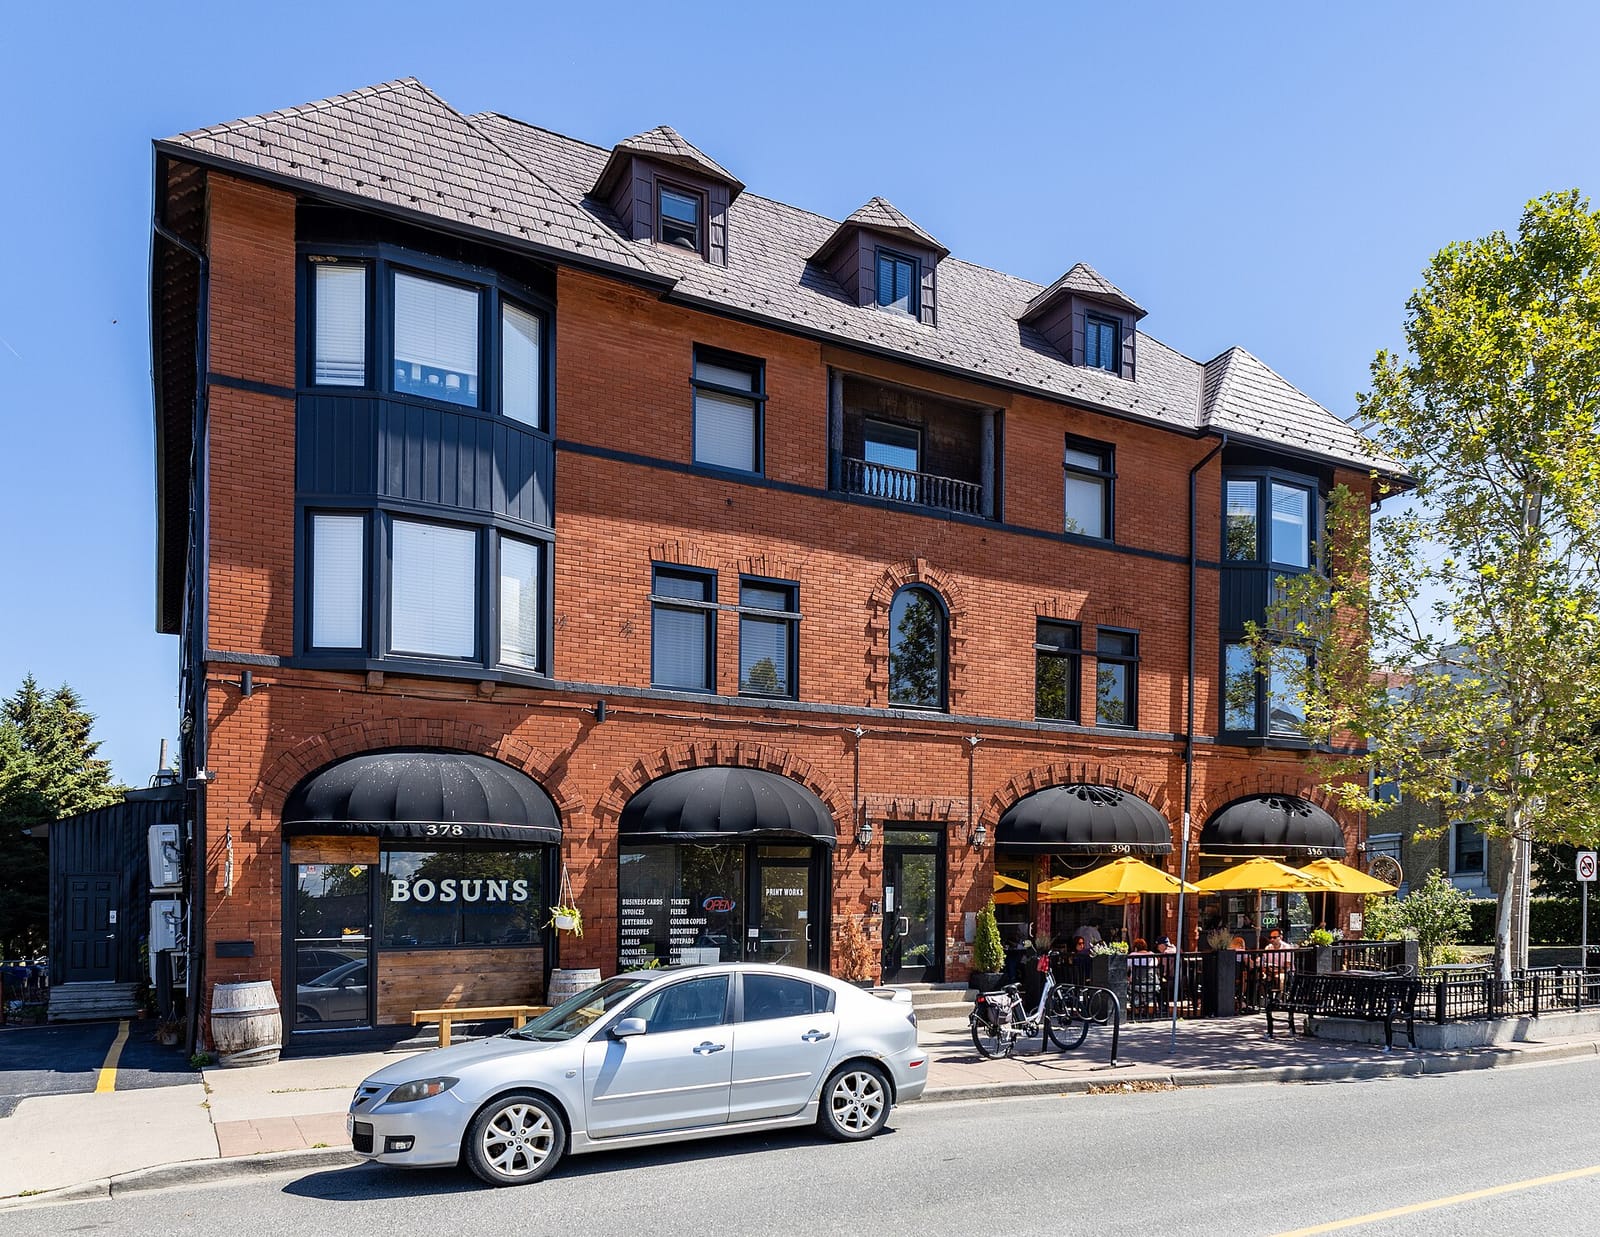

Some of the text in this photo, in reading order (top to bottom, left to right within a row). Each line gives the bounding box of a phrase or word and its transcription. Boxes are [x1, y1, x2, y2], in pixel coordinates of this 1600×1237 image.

[426, 824, 464, 836] 378
[1111, 844, 1131, 854] 390
[390, 879, 529, 902] BOSUNS
[765, 888, 804, 896] PRINT WORKS
[705, 899, 733, 911] OPEN
[622, 918, 654, 926] LETTERHEAD
[669, 937, 695, 945] NOTEPADS
[621, 948, 647, 956] BOOKLETS
